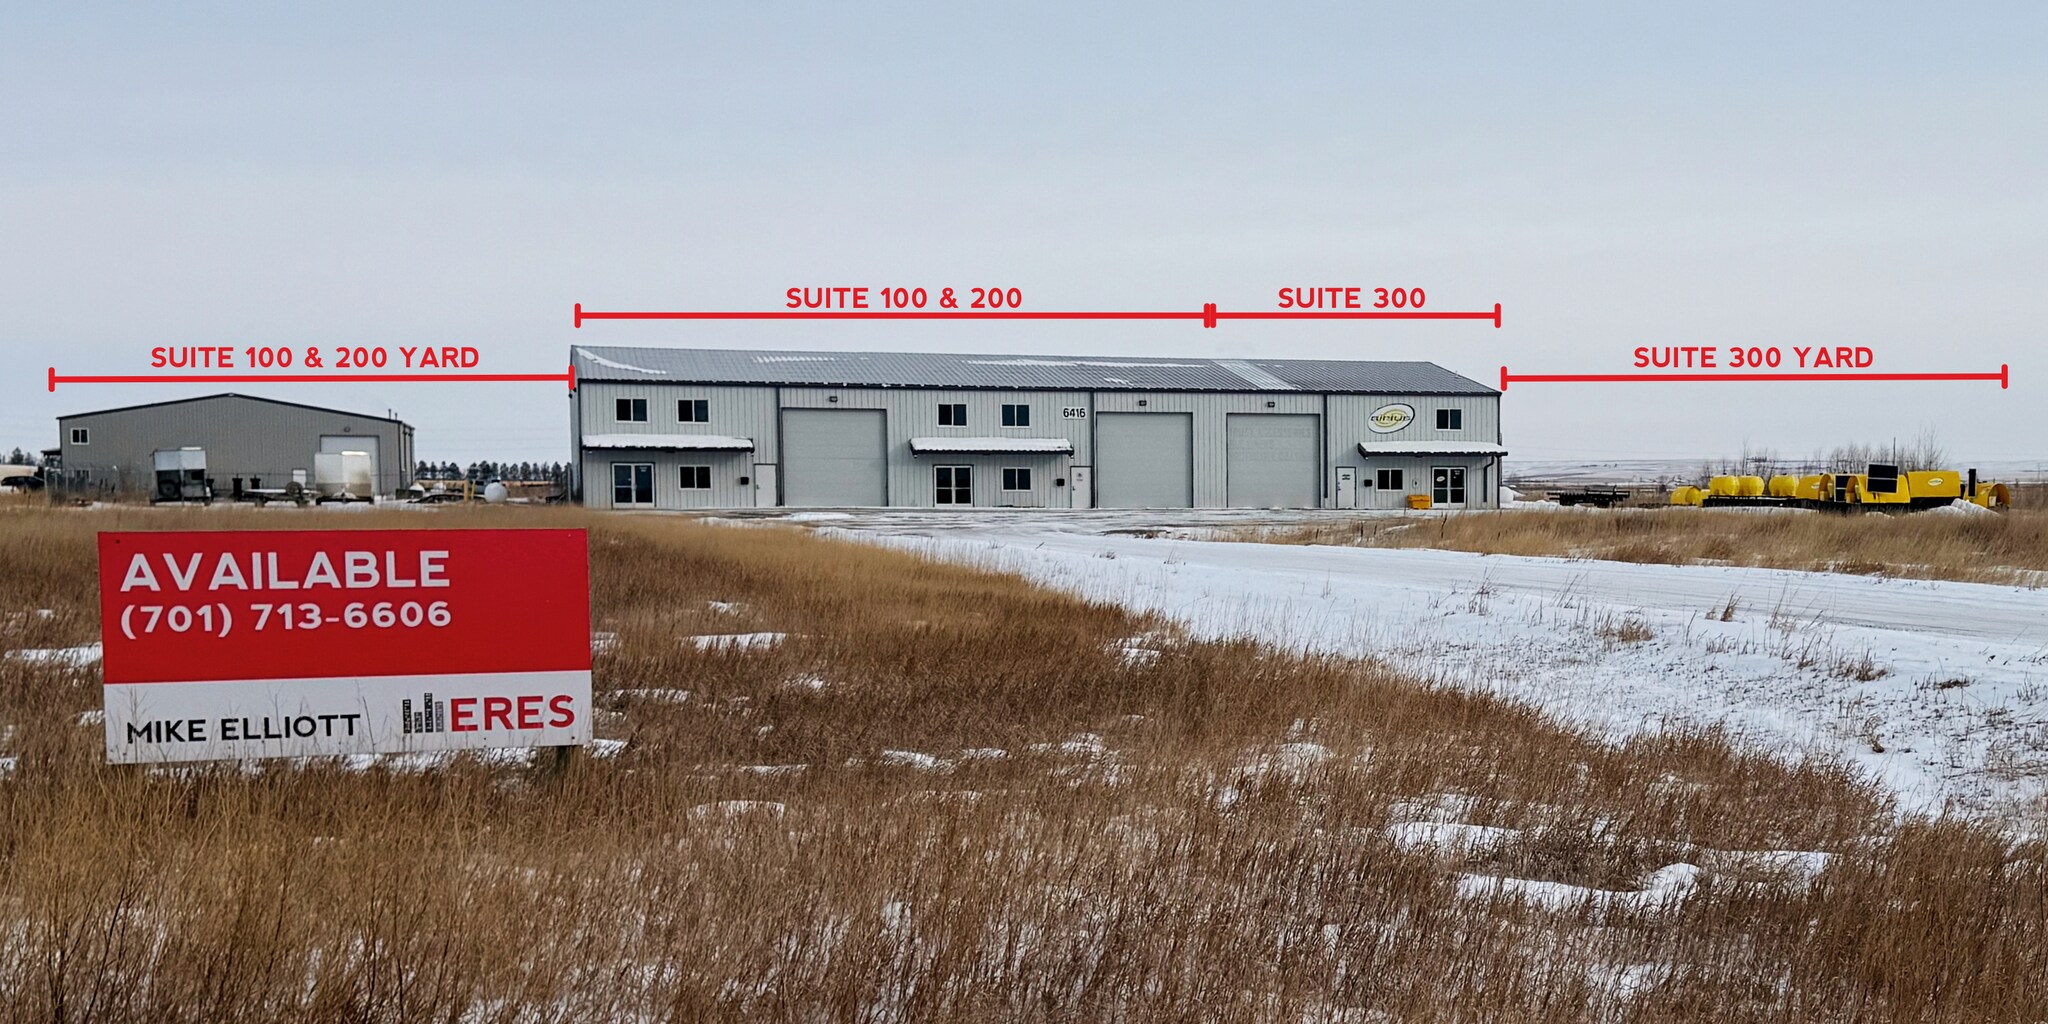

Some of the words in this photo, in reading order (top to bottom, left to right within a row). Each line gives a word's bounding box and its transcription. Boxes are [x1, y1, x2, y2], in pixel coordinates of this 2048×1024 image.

[1063, 408, 1086, 418] 6416
[120, 550, 450, 592] AVAILABLE
[121, 602, 233, 639] (701)
[252, 602, 452, 631] 713-6606
[127, 719, 206, 744] MIKE
[221, 713, 360, 741] ELLIOTT
[451, 695, 575, 732] ERES
